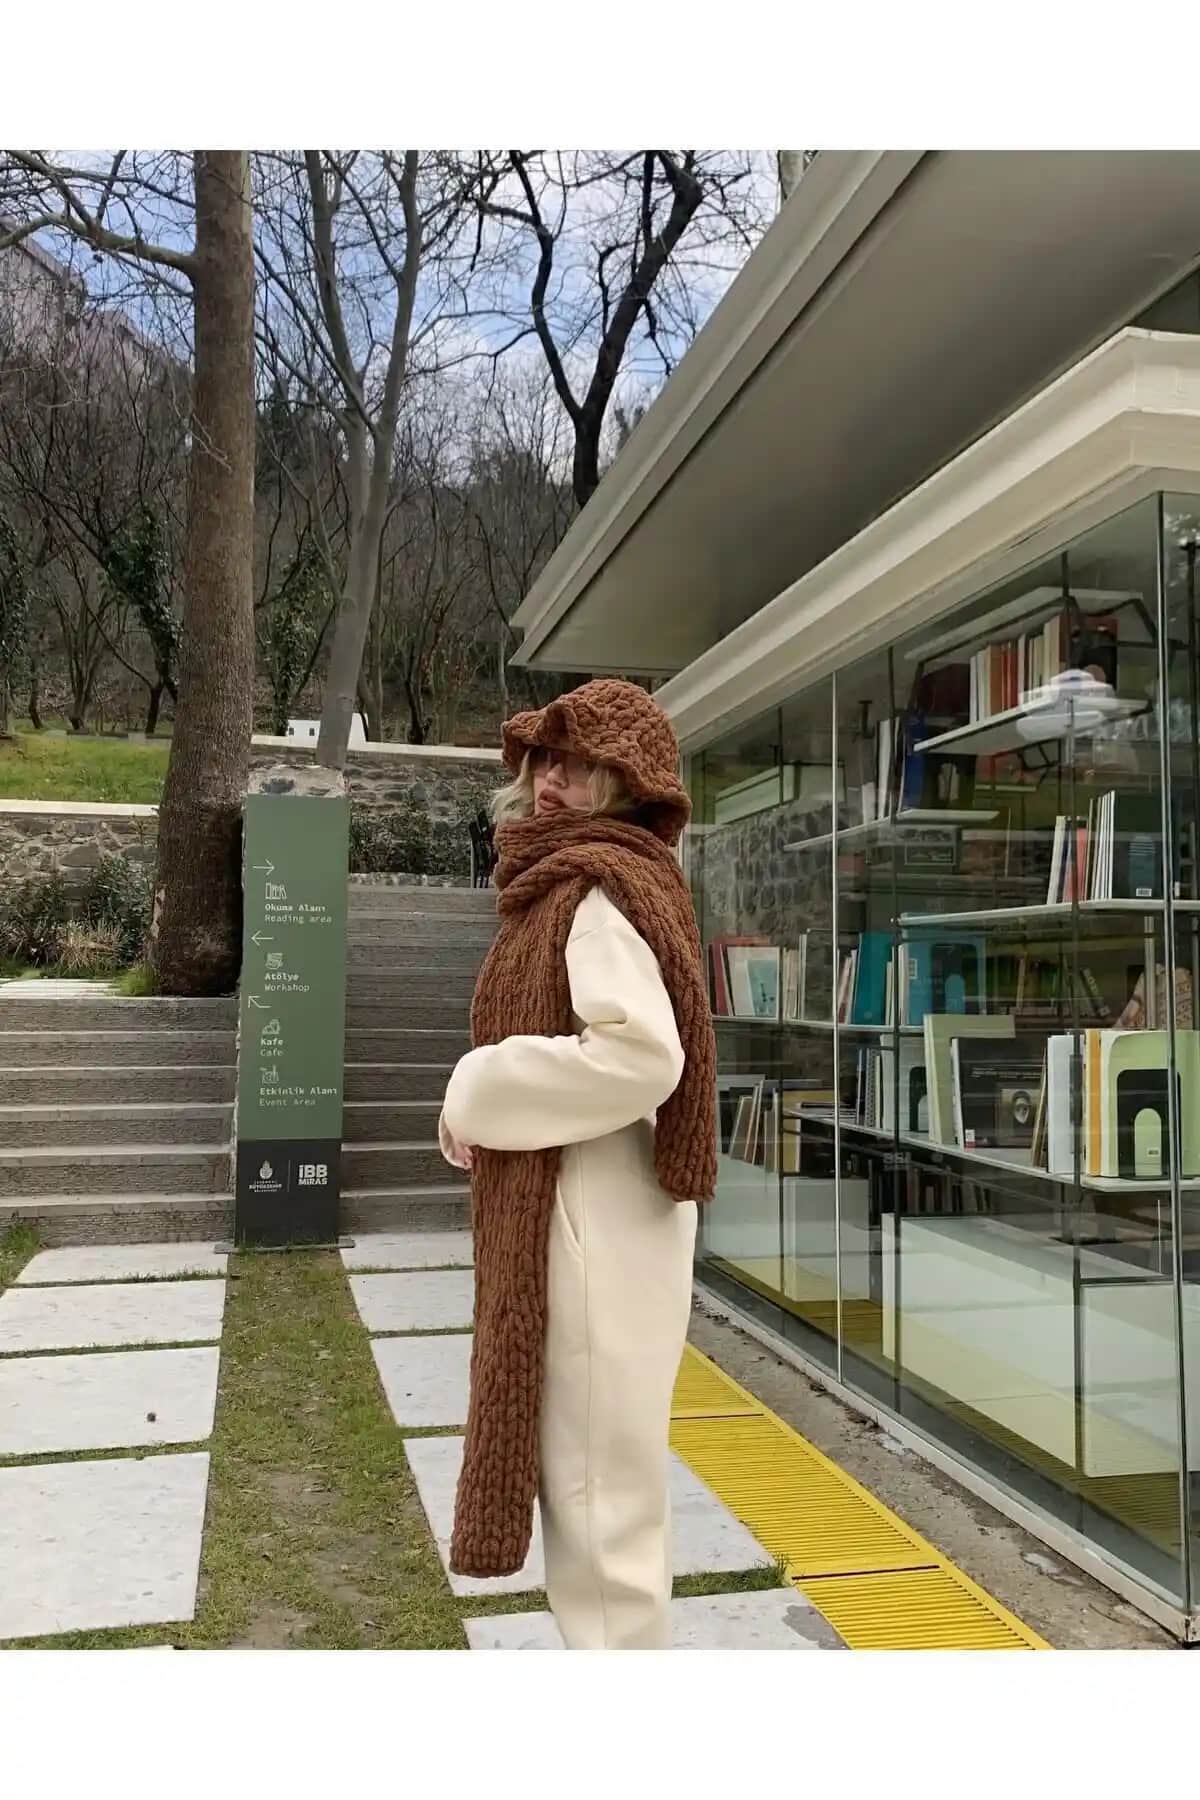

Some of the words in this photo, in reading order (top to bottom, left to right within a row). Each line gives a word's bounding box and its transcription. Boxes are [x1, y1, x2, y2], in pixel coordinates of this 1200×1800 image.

[264, 903, 293, 911] Okuma
[264, 914, 304, 924] Reading
[309, 915, 332, 923] area
[264, 971, 300, 982] Atölye
[264, 984, 310, 993] Workshop
[260, 1037, 284, 1046] Kafe
[260, 1048, 285, 1057] Cafe
[260, 1086, 305, 1096] Etkinlik
[259, 1098, 287, 1106] Event
